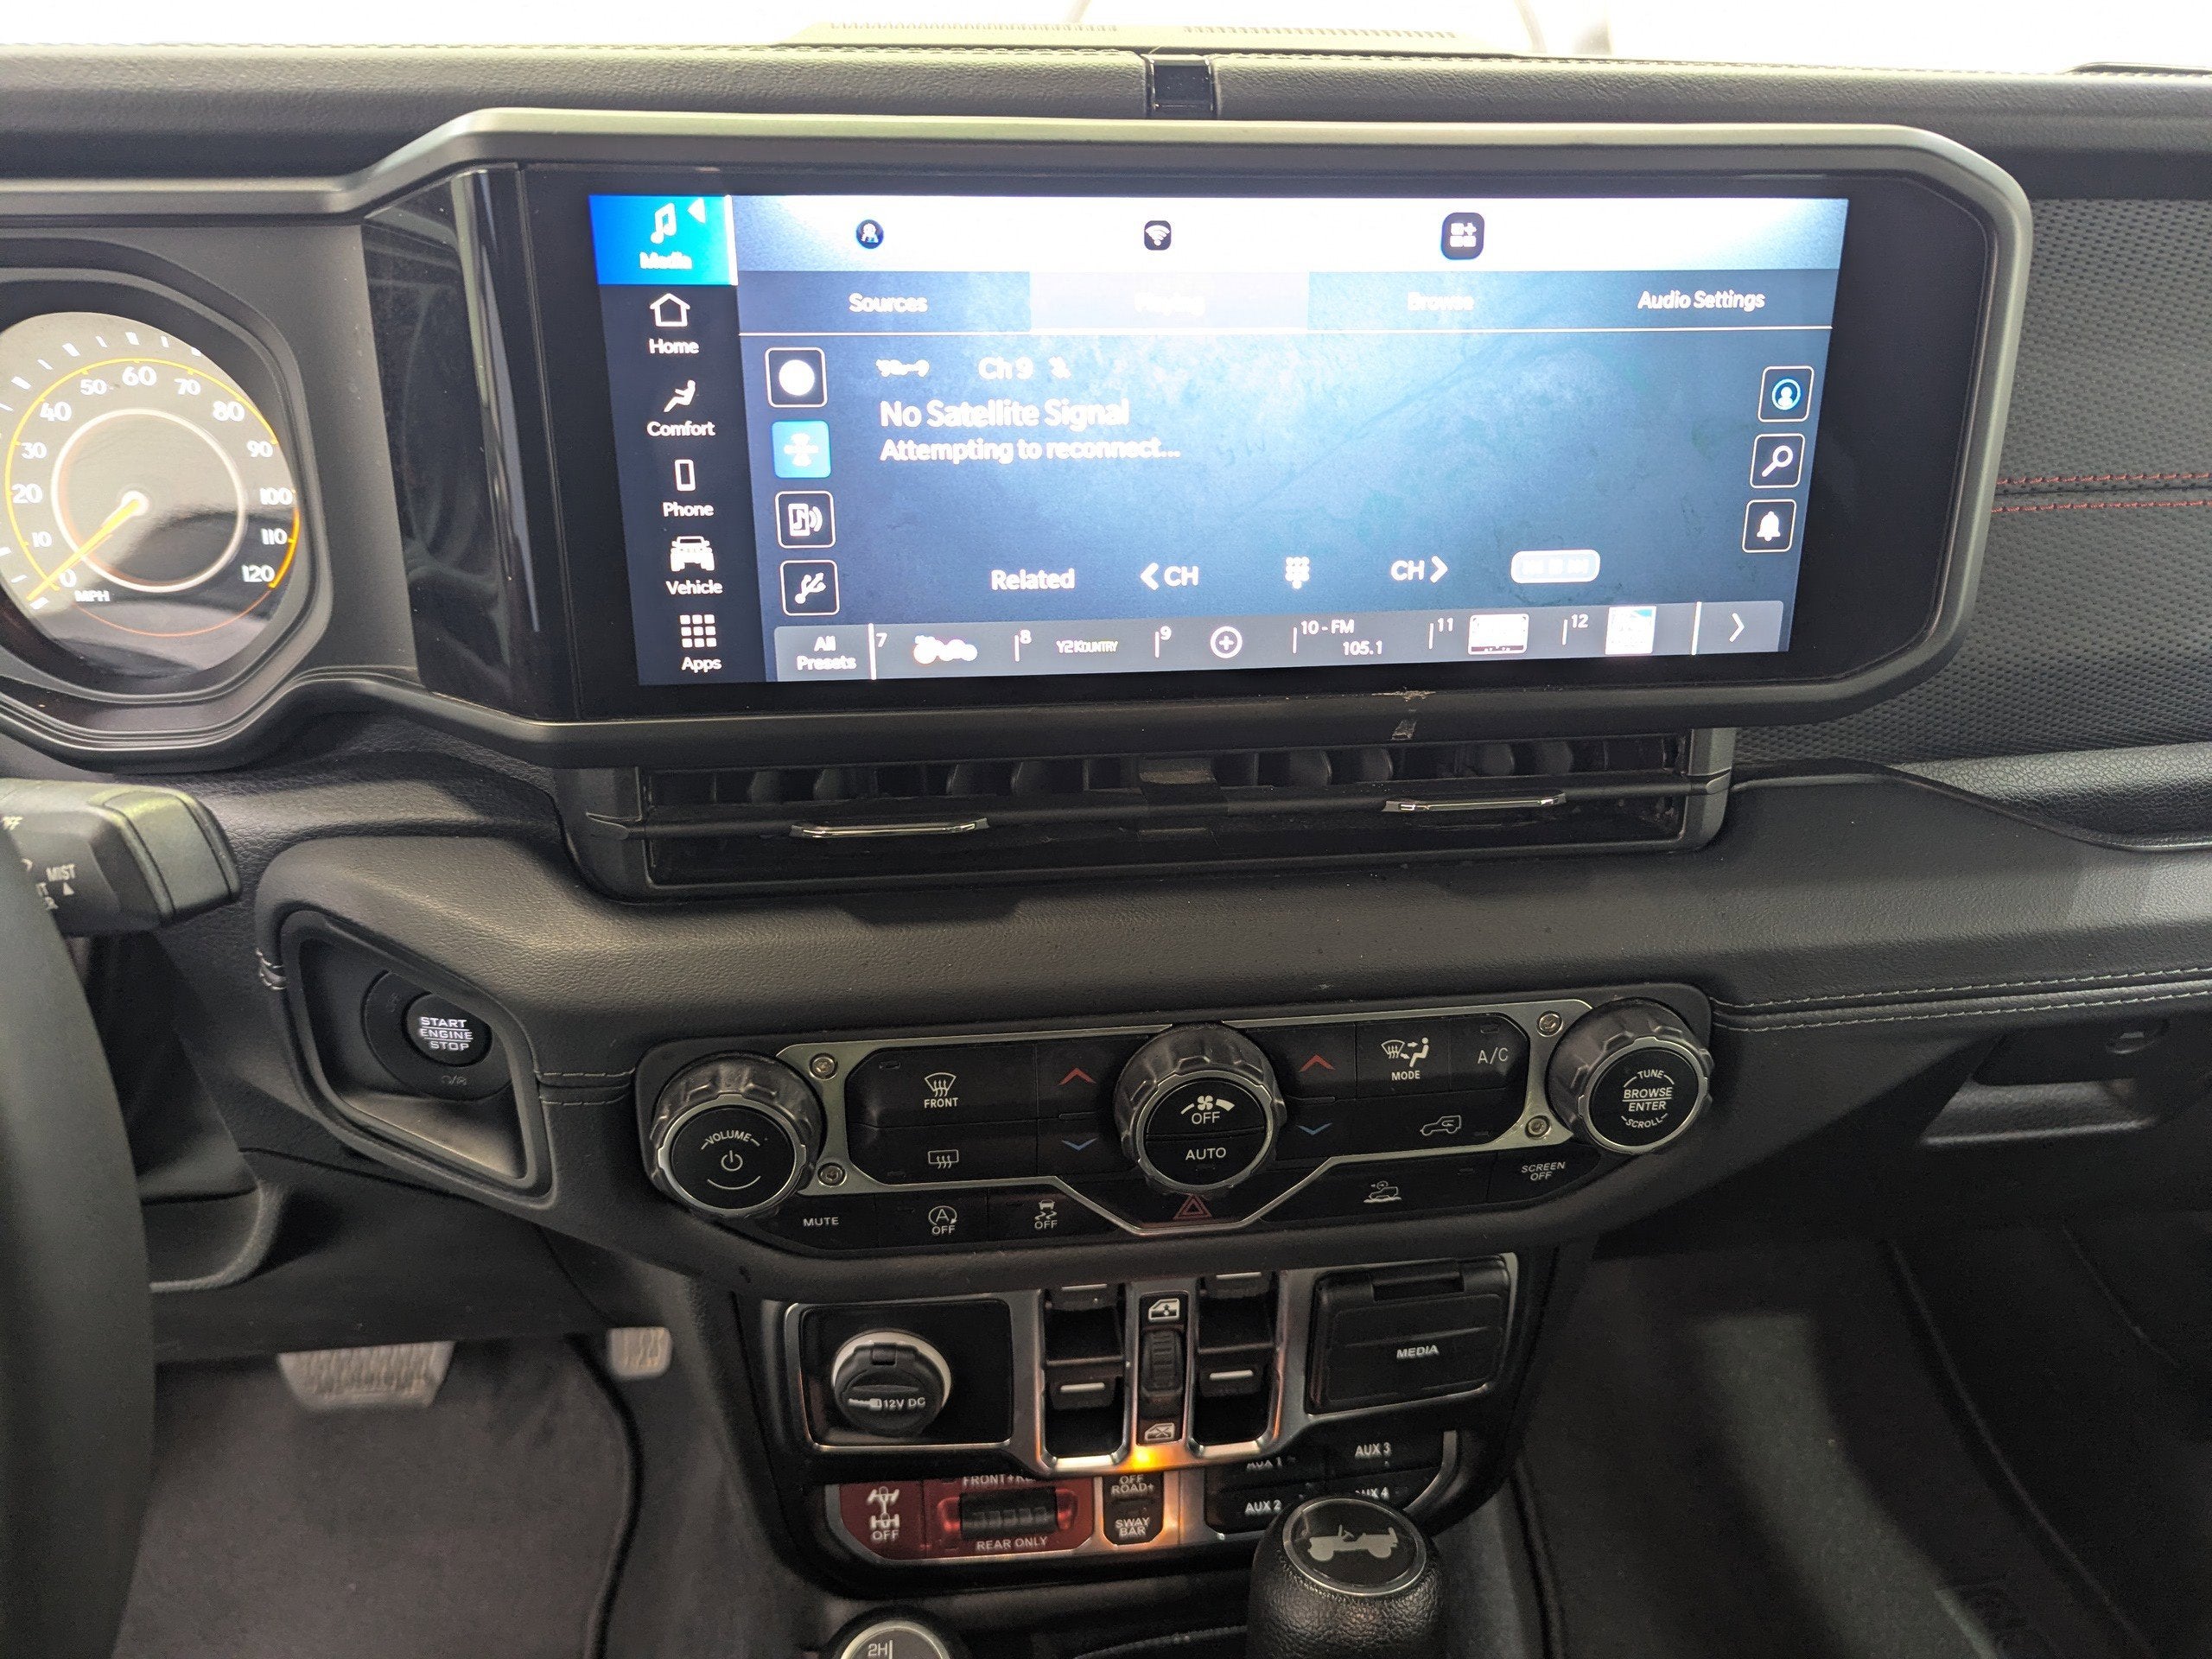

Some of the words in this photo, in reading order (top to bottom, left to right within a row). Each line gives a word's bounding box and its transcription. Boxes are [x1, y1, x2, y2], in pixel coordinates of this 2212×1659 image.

[849, 292, 929, 314] Sources
[1408, 291, 1476, 312] Browse
[1637, 290, 1690, 309] Audio
[1694, 290, 1765, 311] Settings
[649, 338, 700, 354] Home
[122, 365, 157, 386] 60
[978, 356, 1013, 380] Ch
[1015, 357, 1034, 380] 9
[80, 378, 108, 396] 50
[175, 378, 201, 396] 70
[40, 402, 73, 422] 40
[213, 401, 245, 422] 80
[880, 400, 922, 428] No
[927, 399, 1039, 428] Satellite
[1044, 397, 1129, 432] Signal
[647, 421, 716, 437] Comfort
[21, 442, 48, 459] 30
[246, 441, 274, 458] 90
[880, 438, 1014, 465] Attempting
[1018, 439, 1043, 461] to
[1046, 437, 1181, 461] reconnect...
[11, 484, 43, 504] 20
[259, 487, 293, 505] 100
[663, 502, 715, 517] Phone
[32, 532, 52, 548] 10
[261, 528, 288, 545] 110
[59, 569, 77, 588] 0
[242, 565, 276, 583] 120
[1164, 566, 1199, 588] CH
[1390, 560, 1426, 582] CH
[665, 580, 723, 595] Vehicle
[991, 568, 1076, 592] Related
[75, 590, 110, 603] MPH
[1300, 620, 1319, 635] 10
[1331, 619, 1355, 634] FM
[1436, 617, 1454, 632] 11
[1571, 613, 1589, 629] 12
[875, 632, 888, 648] 7
[1020, 629, 1033, 645] 8
[1160, 627, 1173, 642] 9
[814, 635, 836, 652] All
[1342, 640, 1382, 657] 105.1
[681, 657, 722, 674] Apps
[797, 655, 857, 671] Presets
[46, 863, 76, 882] MIST
[419, 1016, 467, 1028] START
[418, 1027, 474, 1040] ENGINE
[429, 1040, 470, 1052] STOP
[1478, 1046, 1509, 1065] A/C
[1391, 1070, 1421, 1082] MODE
[1637, 1068, 1665, 1080] TUNE
[1623, 1086, 1673, 1099] BROWSE
[924, 1096, 959, 1109] FRONT
[1628, 1101, 1667, 1112] ENTER
[1192, 1111, 1221, 1125] OFF
[1625, 1117, 1664, 1129] SCROLL
[705, 1129, 753, 1146] VOLUME
[1185, 1147, 1227, 1160] AUTO
[1521, 1161, 1567, 1173] SCREEN
[1530, 1171, 1553, 1181] OFF
[803, 1216, 840, 1228] MUTE
[931, 1224, 956, 1235] OFF
[1034, 1219, 1058, 1230] OFF
[1396, 1344, 1440, 1360] MEDIA
[883, 1396, 906, 1409] 12V
[907, 1396, 926, 1409] DC
[1355, 1443, 1382, 1459] AUX
[1383, 1441, 1392, 1458] 3
[1119, 1474, 1143, 1484] OFF
[1111, 1482, 1154, 1495] ROAD+
[1381, 1486, 1390, 1501] 4
[1244, 1500, 1272, 1516] AUX
[1272, 1499, 1283, 1515] 2
[1115, 1516, 1150, 1529] SWAY
[872, 1529, 899, 1542] OFF
[1118, 1526, 1147, 1538] BAR
[976, 1538, 1012, 1552] REAR
[1014, 1535, 1048, 1549] ONLY
[868, 1643, 888, 1657] 2H
